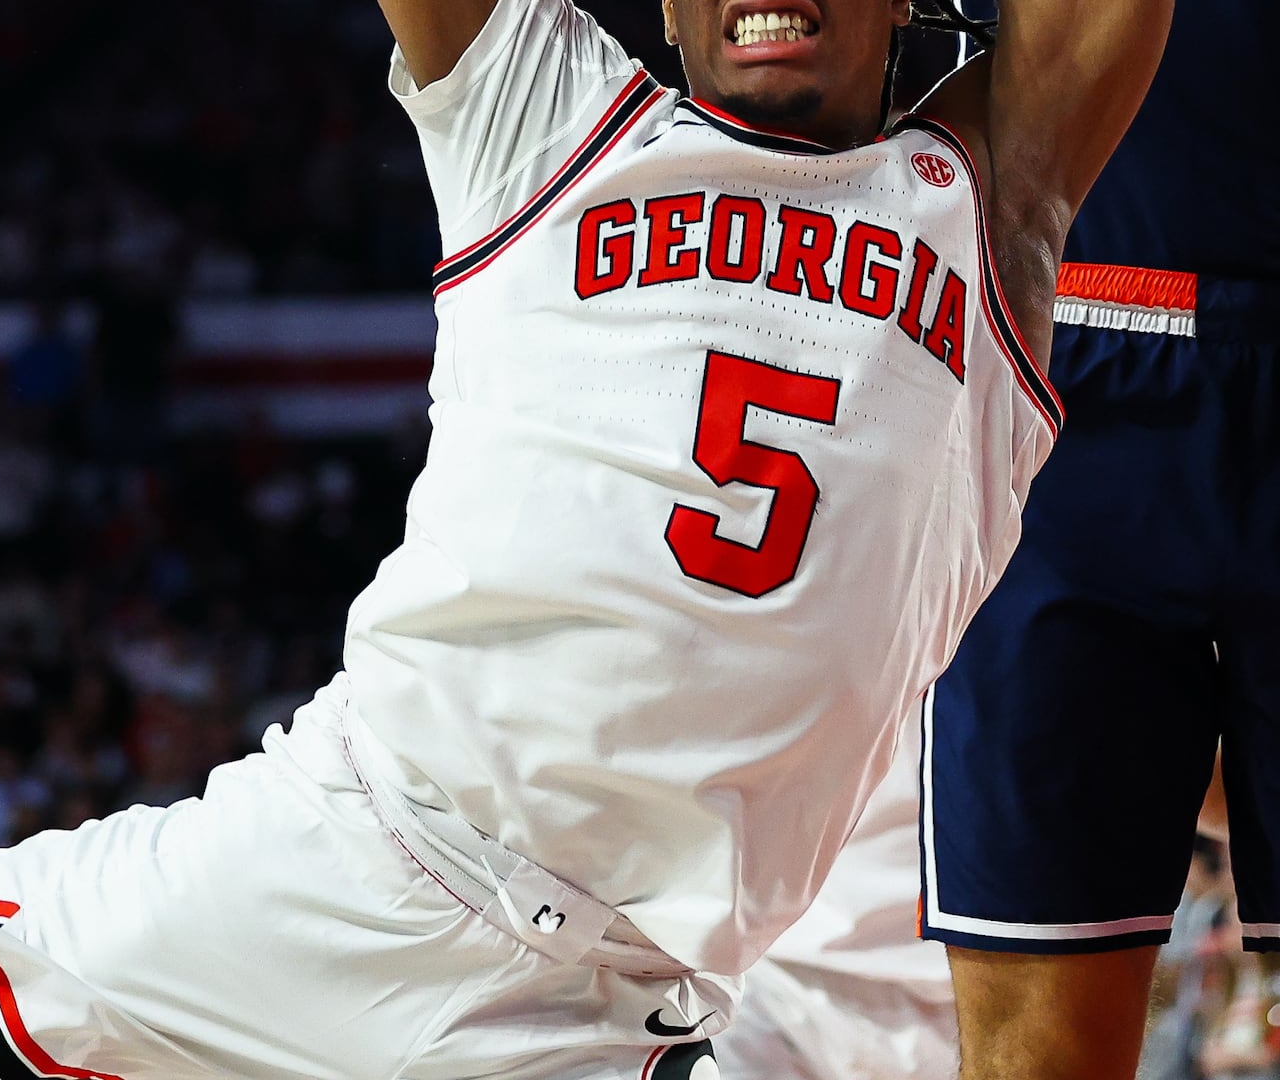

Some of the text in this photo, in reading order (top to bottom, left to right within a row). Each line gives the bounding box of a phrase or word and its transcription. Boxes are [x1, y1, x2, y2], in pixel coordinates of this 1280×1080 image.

[912, 154, 953, 185] SEC
[574, 191, 967, 386] GEORGIA
[664, 349, 842, 599] 5
